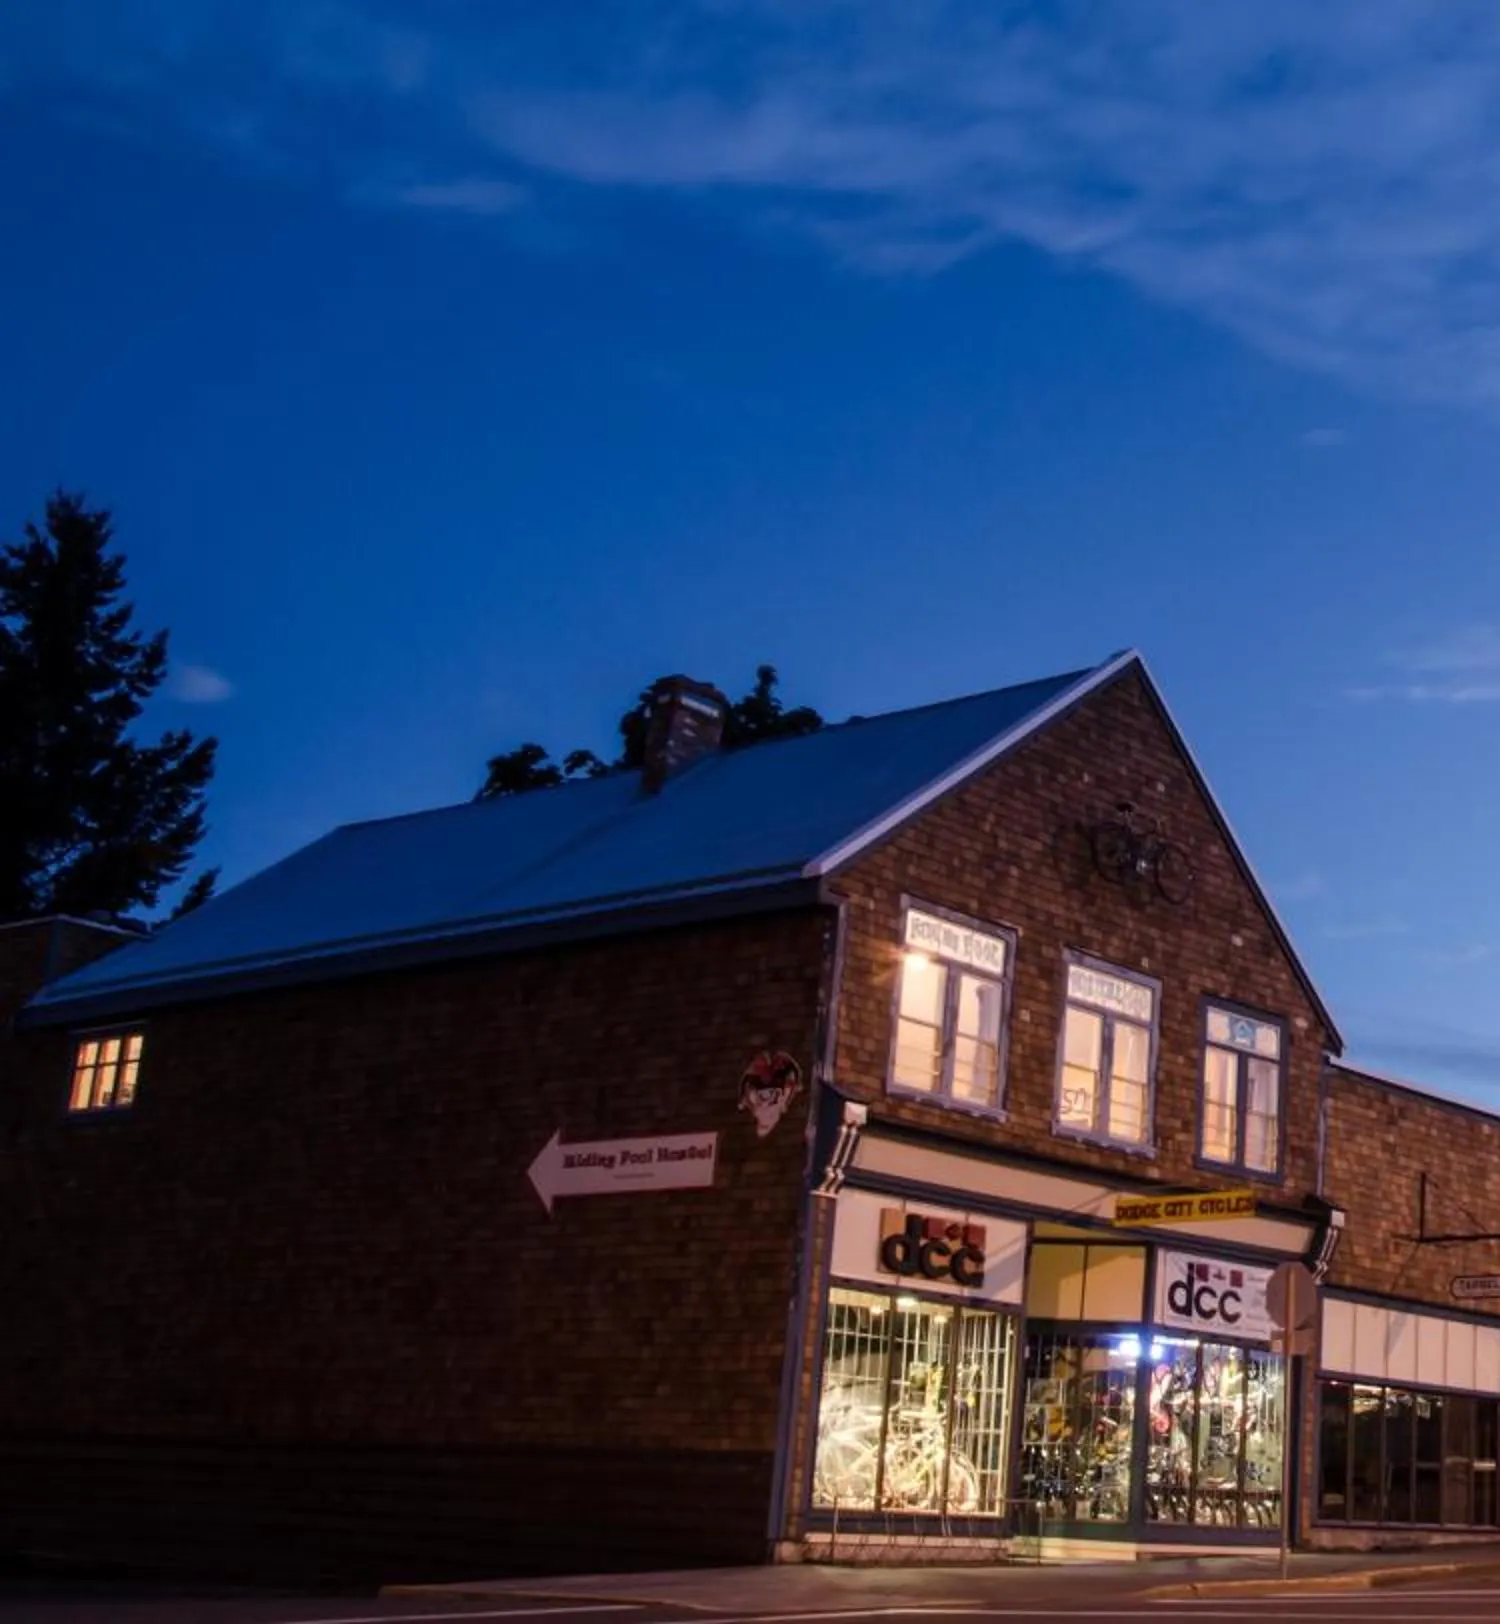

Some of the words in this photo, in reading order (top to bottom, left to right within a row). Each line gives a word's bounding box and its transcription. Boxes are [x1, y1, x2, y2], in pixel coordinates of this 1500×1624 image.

[562, 1153, 616, 1169] Riding
[1116, 1203, 1162, 1220] DODGE
[1164, 1200, 1194, 1217] CITY
[1198, 1196, 1253, 1214] CYCLES
[881, 1213, 985, 1289] dcc
[1167, 1262, 1242, 1324] dcc
